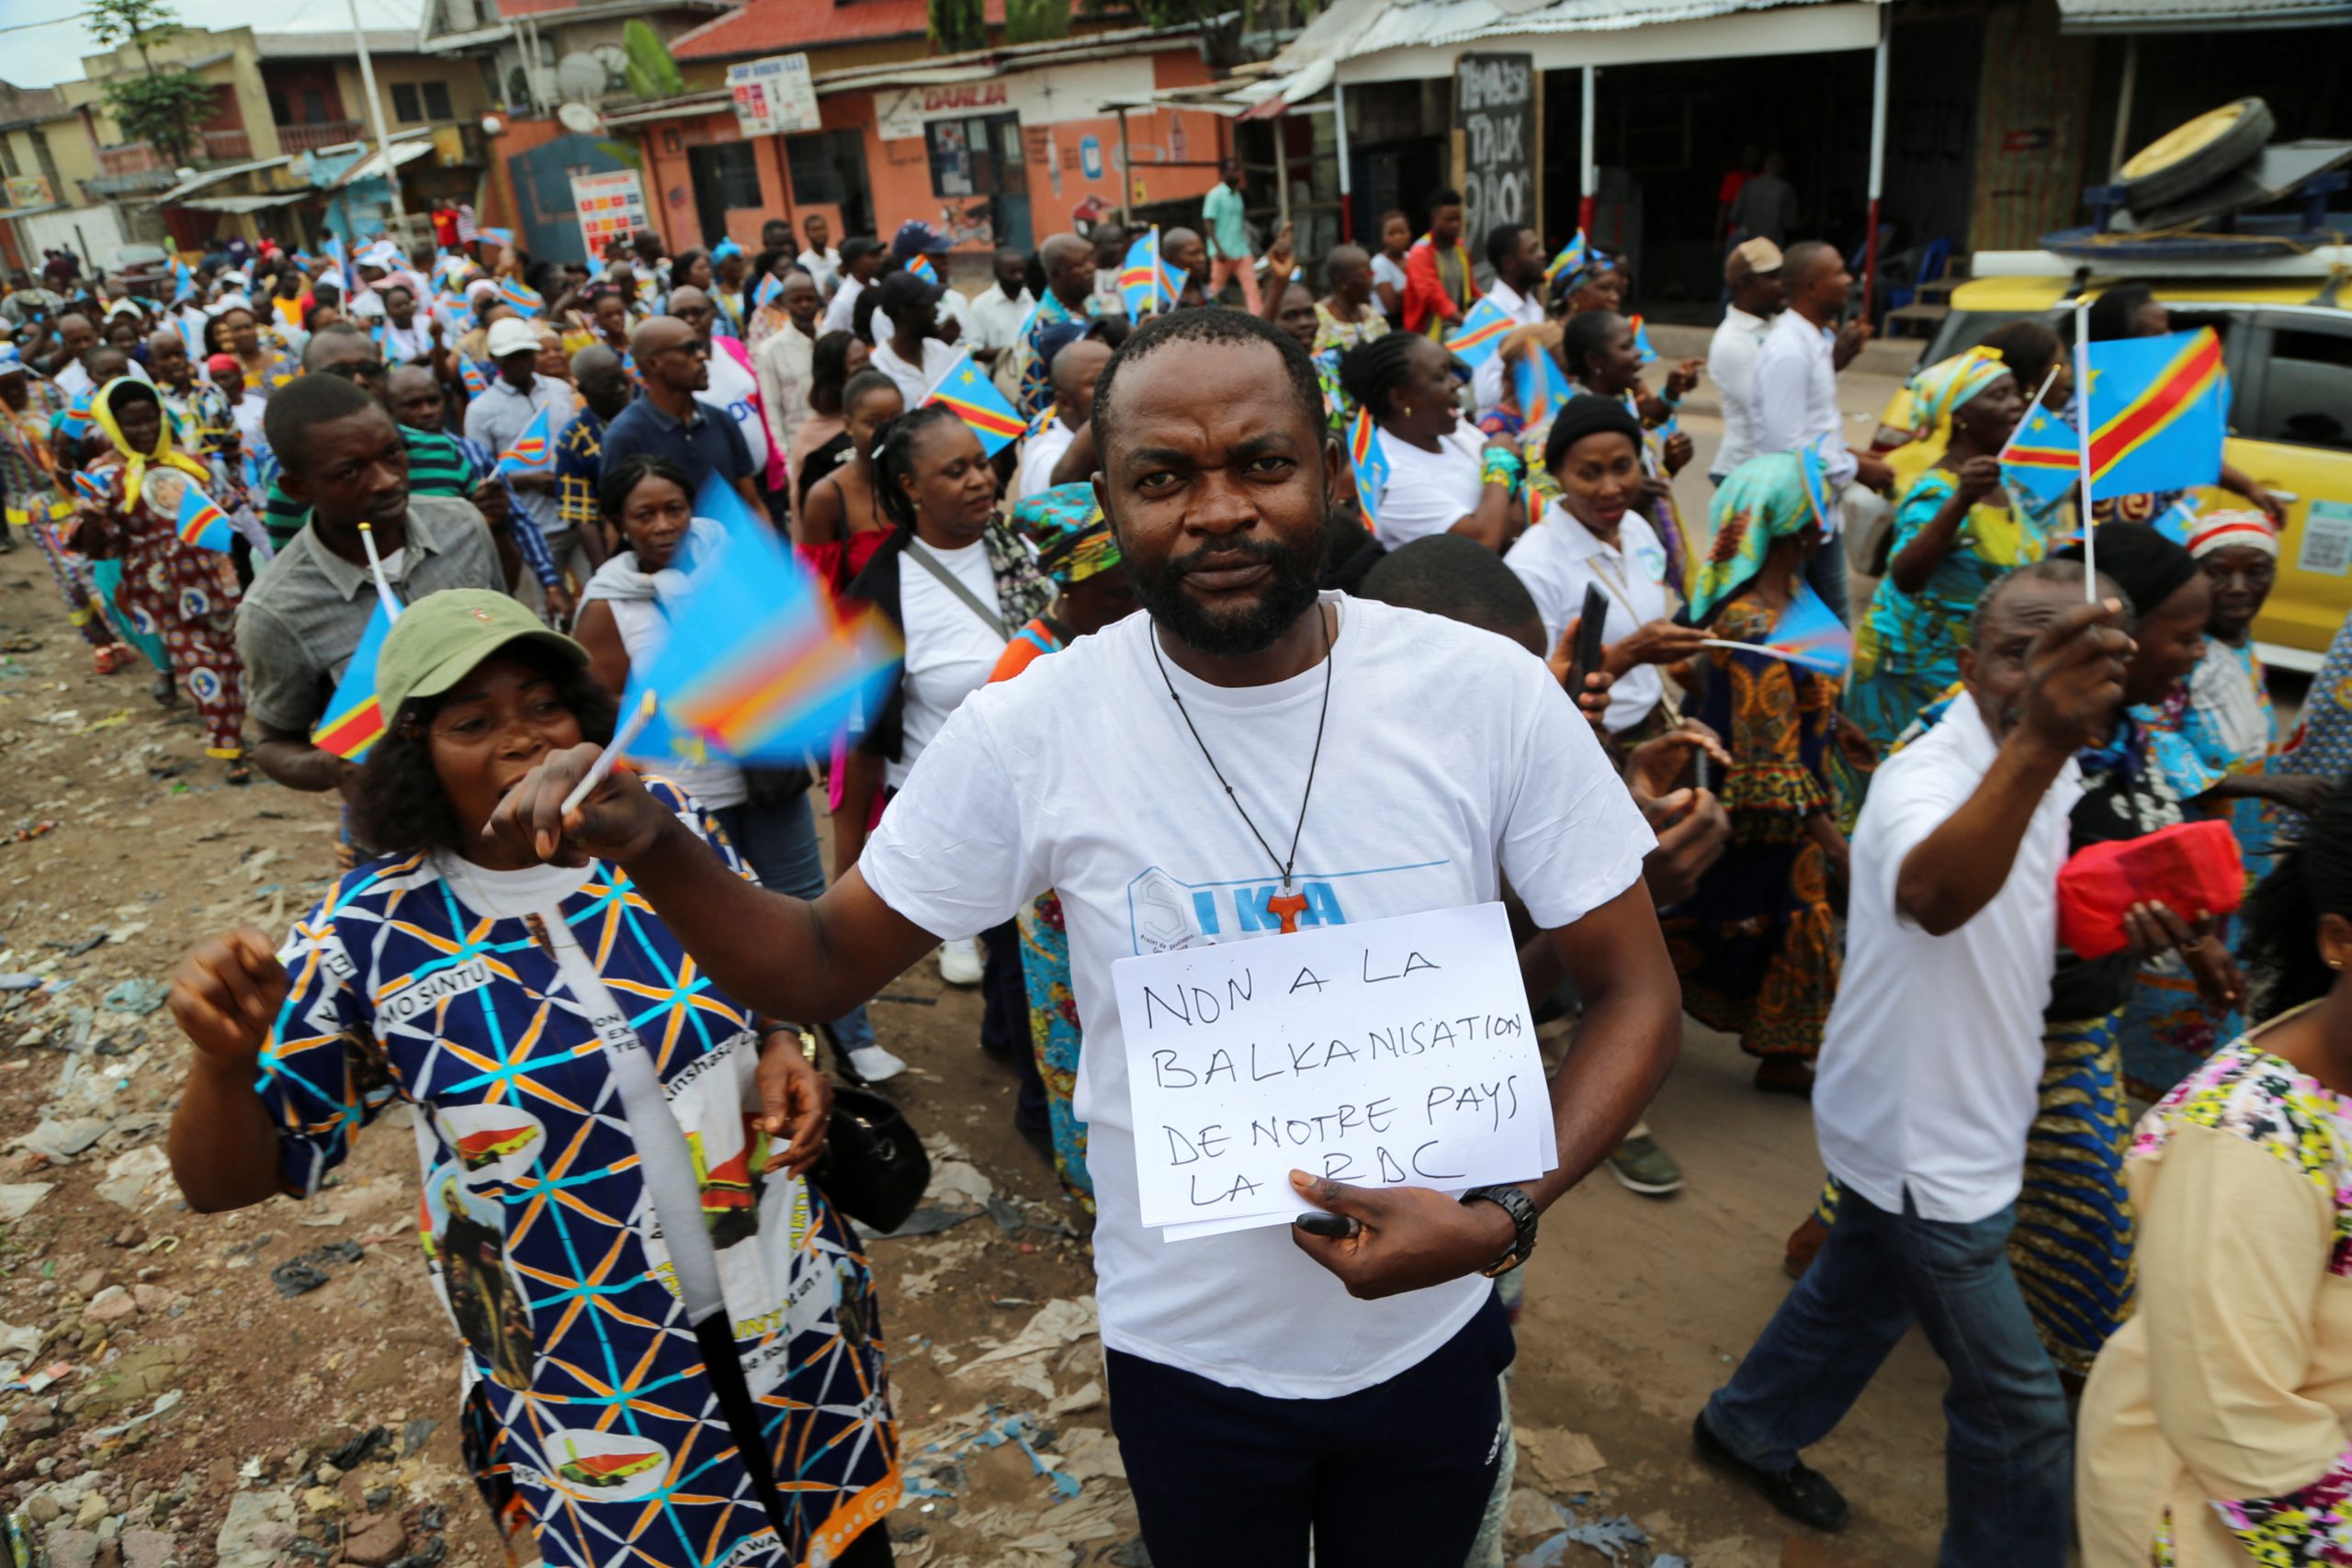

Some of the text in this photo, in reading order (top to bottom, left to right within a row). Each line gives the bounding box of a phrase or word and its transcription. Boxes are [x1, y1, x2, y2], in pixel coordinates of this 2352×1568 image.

[1143, 949, 1442, 1028] NON A LA
[1152, 1011, 1521, 1089] BALKANISATION
[1162, 1074, 1519, 1166] DE NOTRE PAYS
[1191, 1139, 1466, 1207] LA RDC
